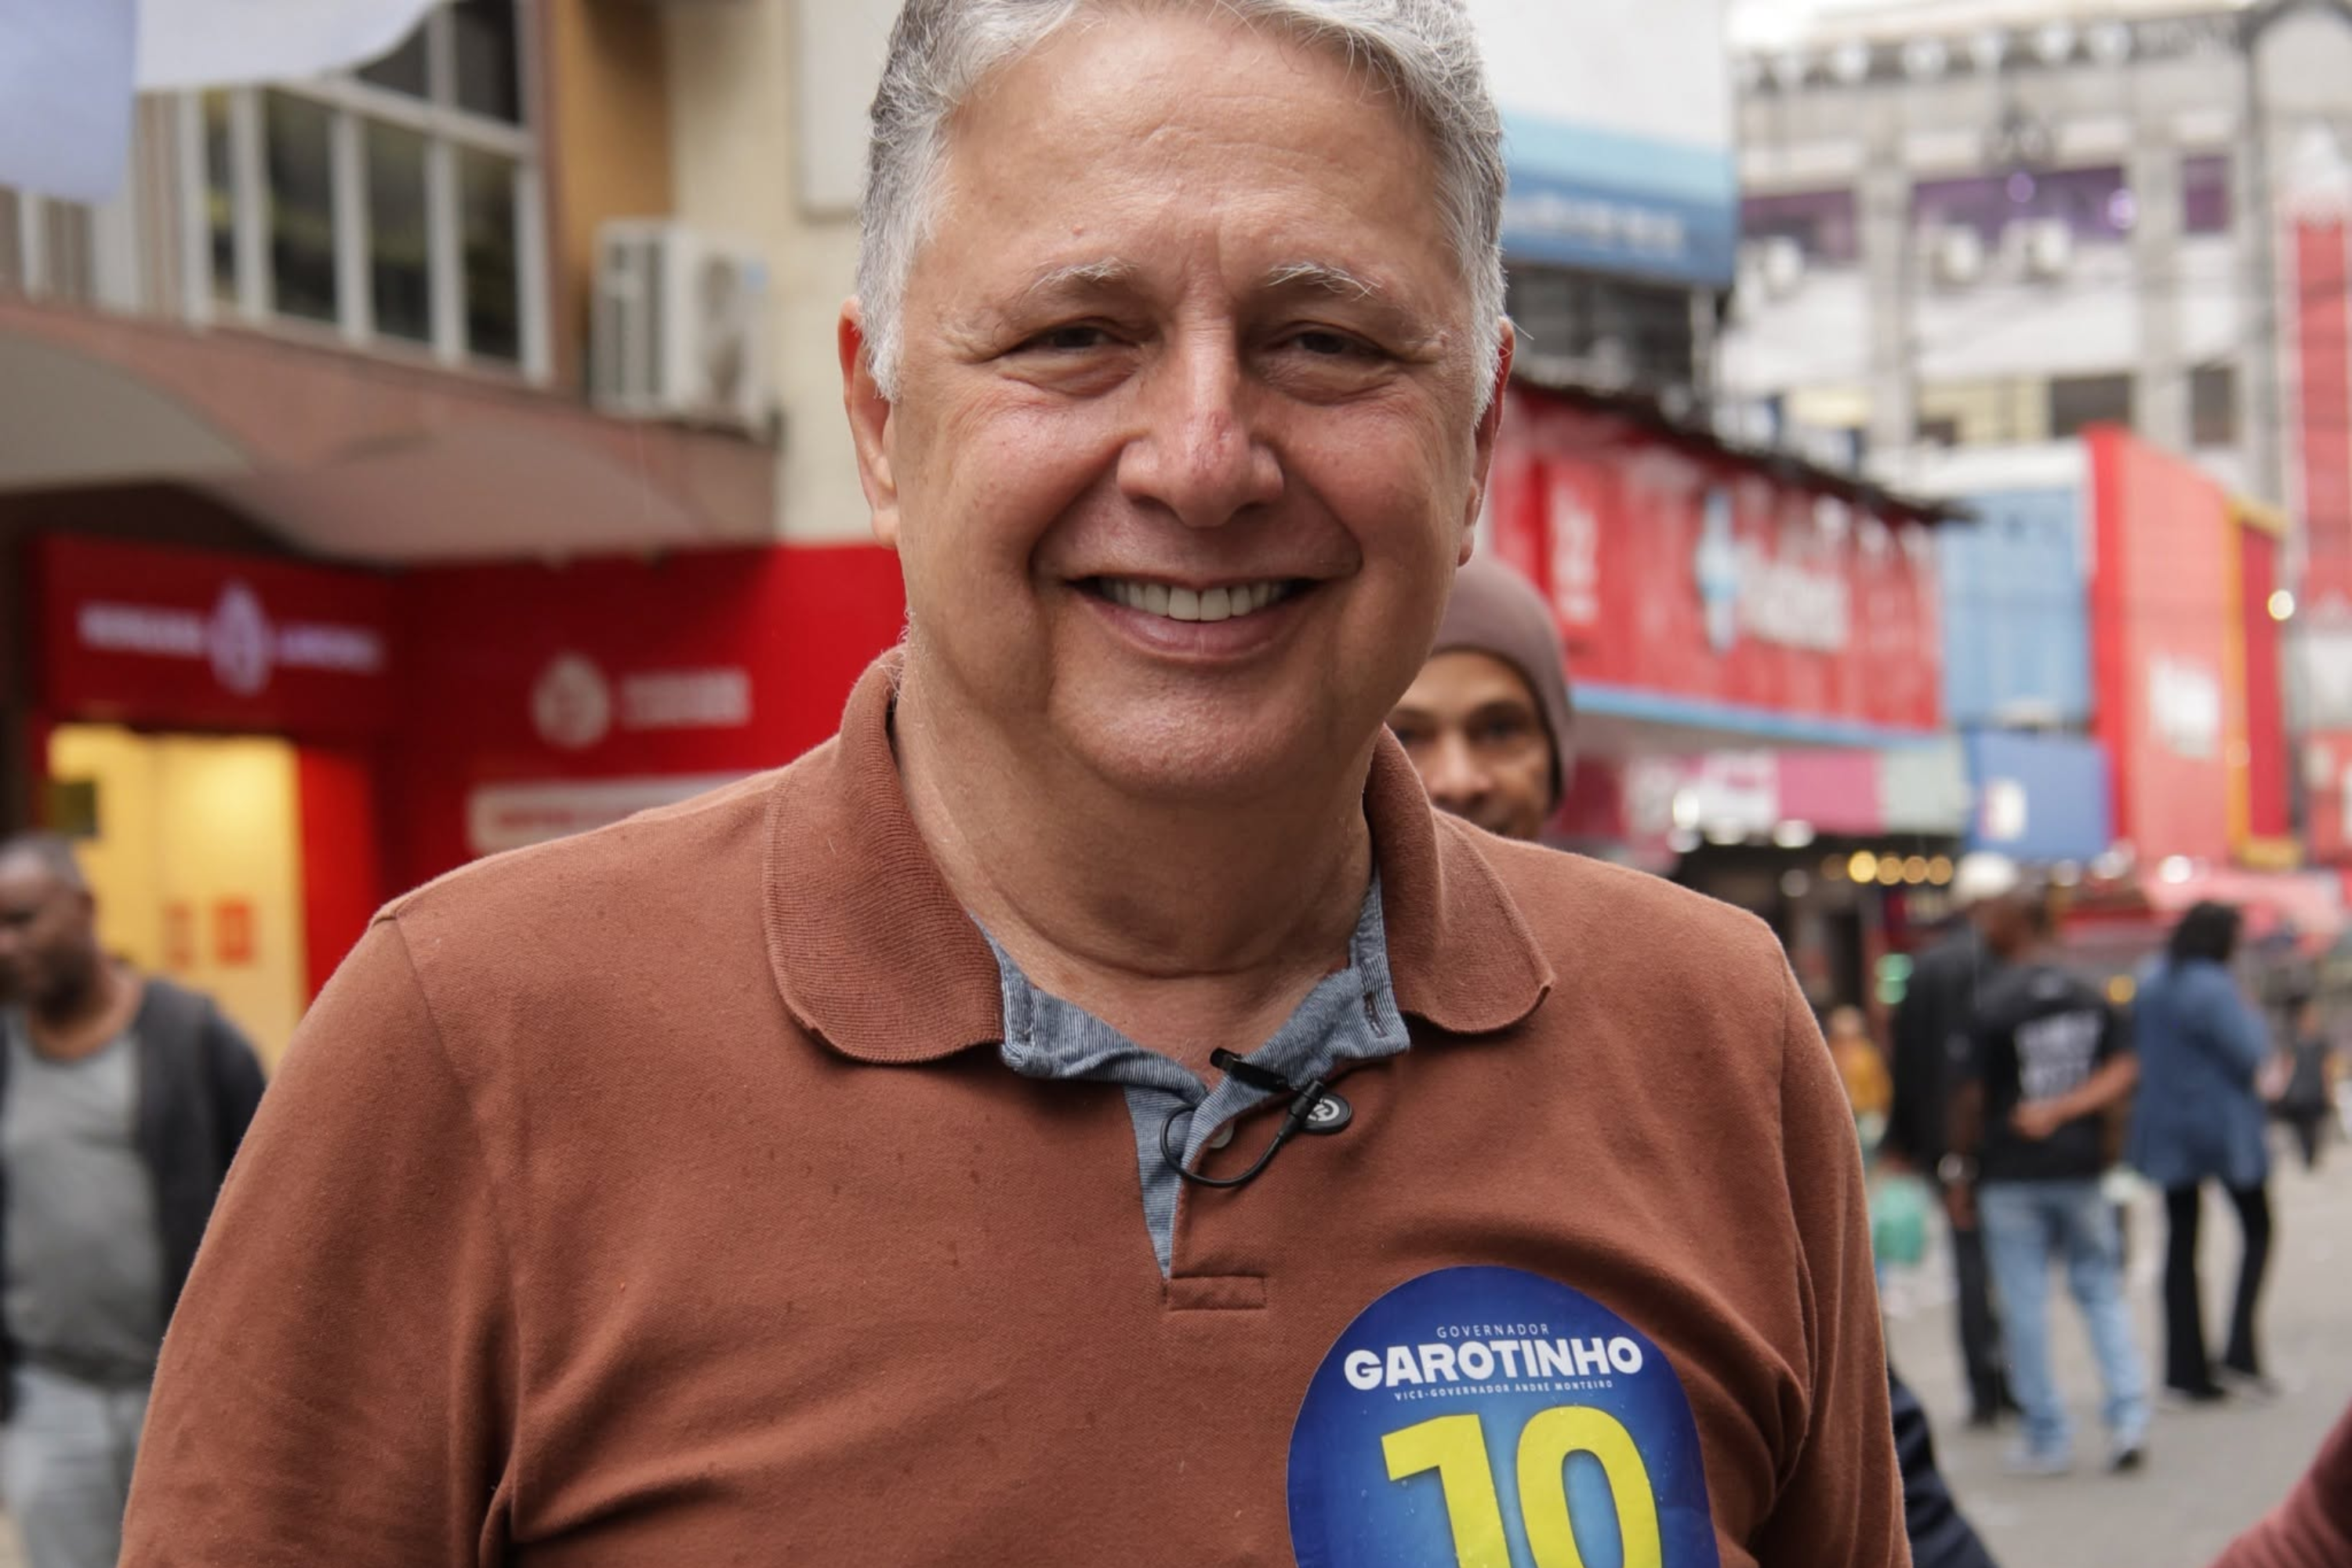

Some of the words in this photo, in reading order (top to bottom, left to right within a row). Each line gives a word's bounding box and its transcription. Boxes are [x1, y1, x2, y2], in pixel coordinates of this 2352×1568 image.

[1436, 1323, 1550, 1339] GOVERNADOR
[1344, 1336, 1643, 1391] GAROTINHO
[1394, 1384, 1510, 1402] VICE-GOVERNADOR
[1554, 1379, 1613, 1392] MONTEIRO
[1381, 1406, 1664, 1568] 10
